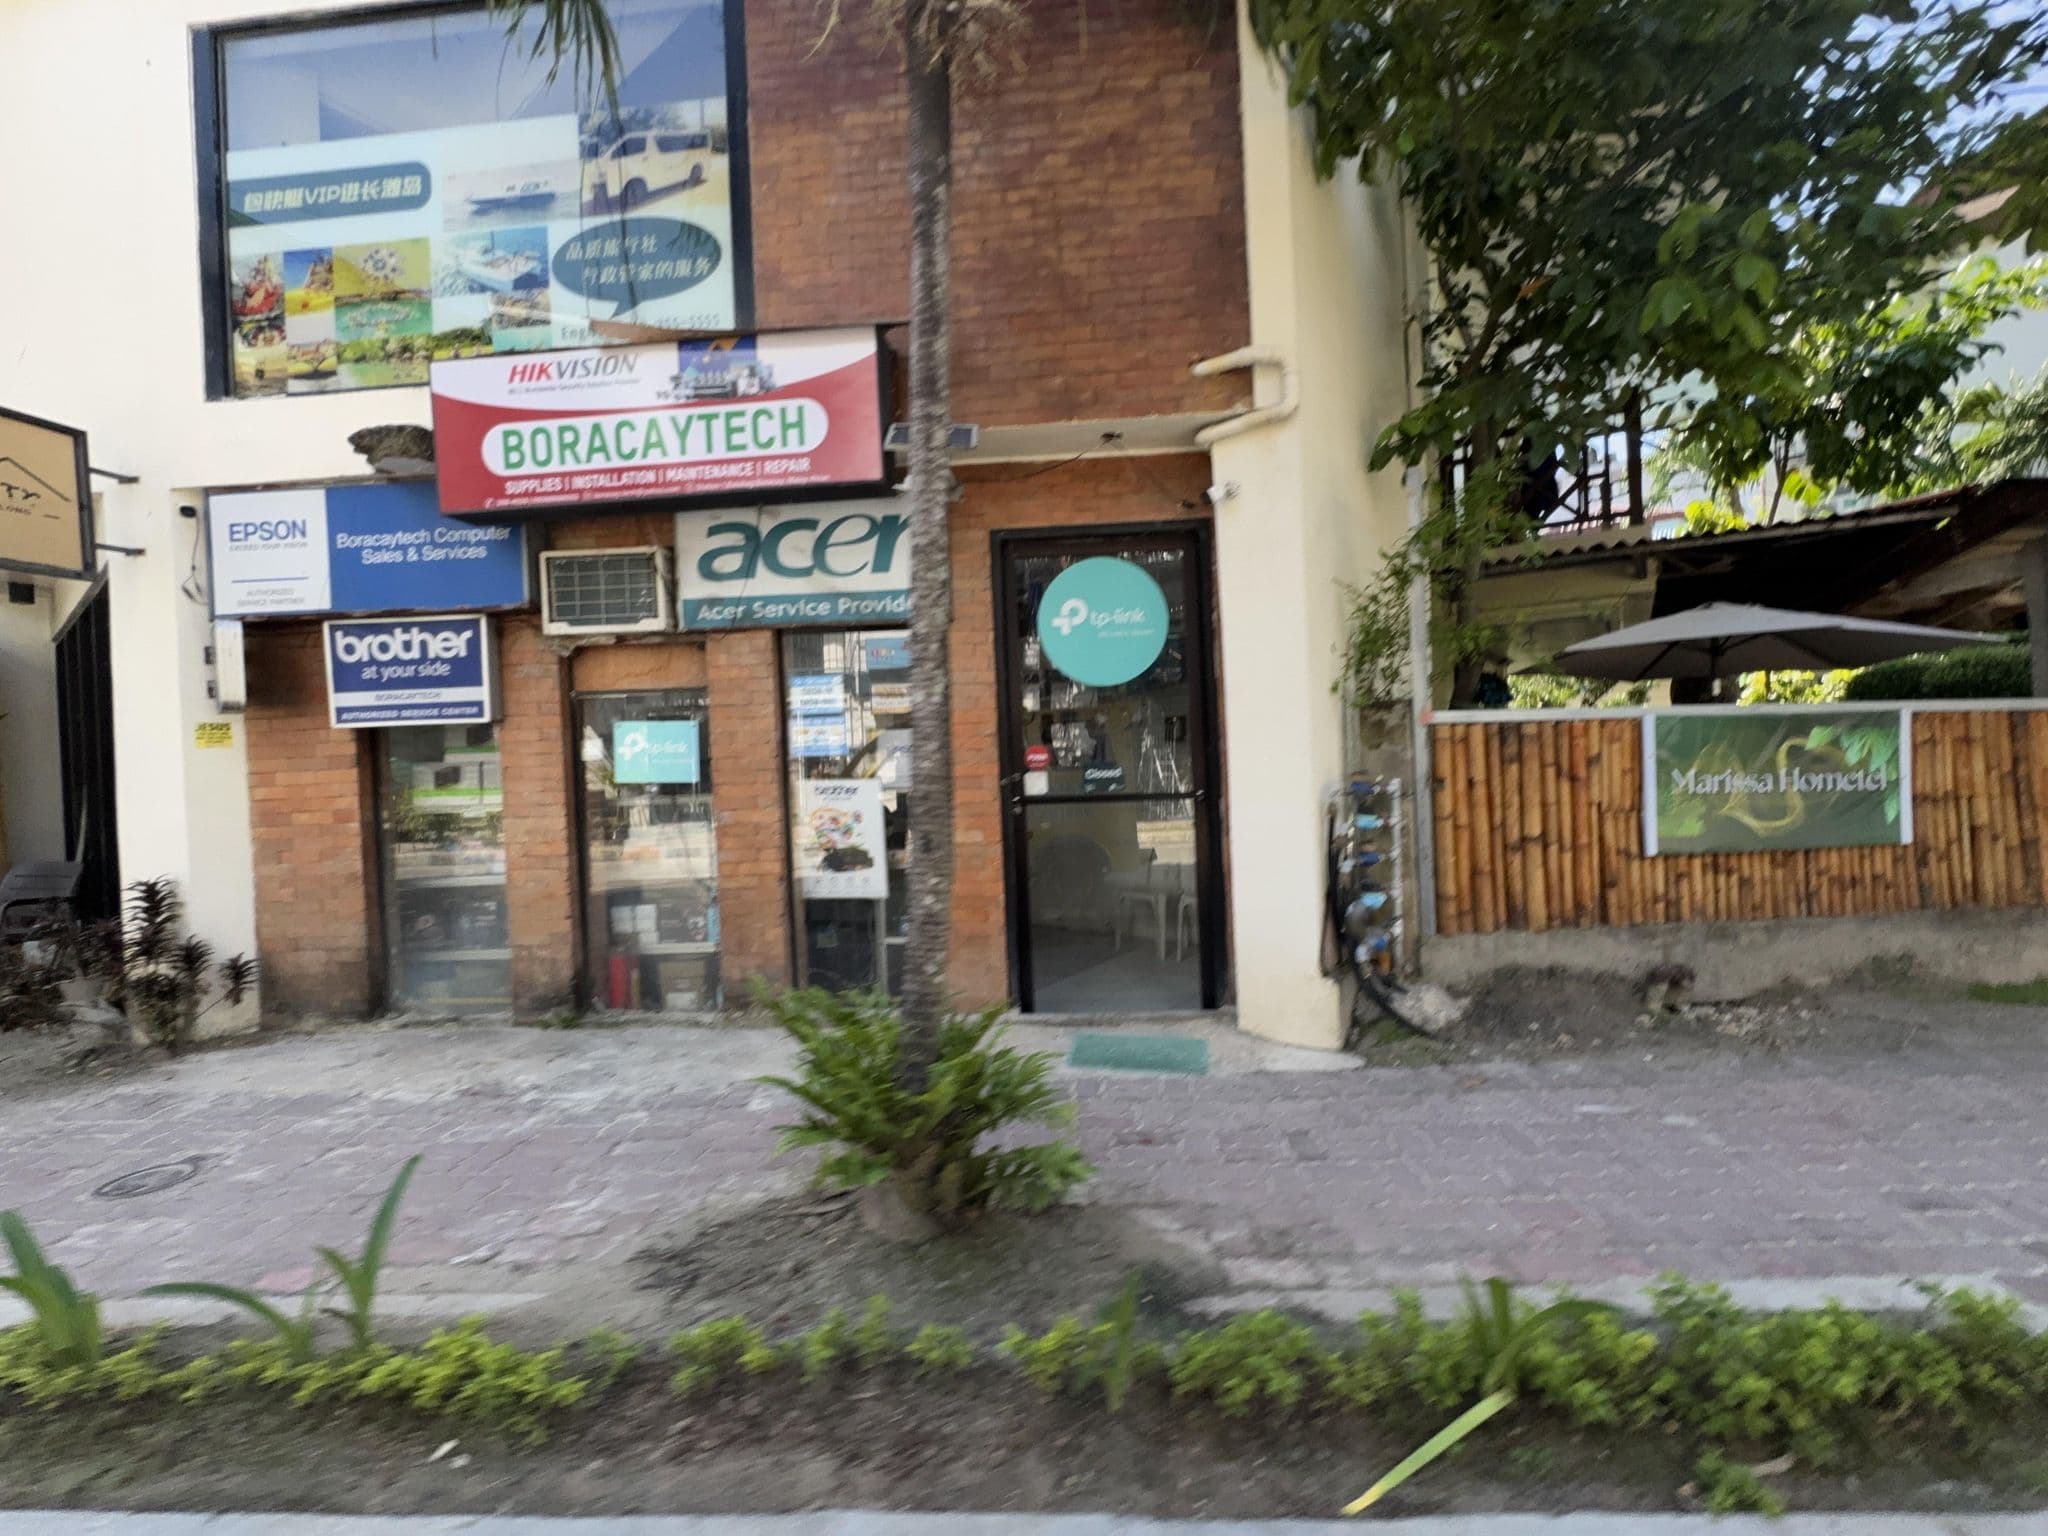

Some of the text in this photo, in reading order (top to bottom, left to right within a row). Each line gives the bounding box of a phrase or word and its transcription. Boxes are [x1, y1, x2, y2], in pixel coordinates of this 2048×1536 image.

[508, 353, 640, 385] HIKVISION
[502, 404, 807, 471] BORACAYTECH
[505, 477, 562, 496] SUPPLIES
[572, 469, 656, 491] INSTALLATION
[666, 462, 754, 483] MAINTENANCE
[764, 457, 812, 474] REPAIR
[228, 519, 307, 542] EPSON
[336, 526, 512, 549] Boracaytech Computer
[361, 544, 488, 565] Sales & Services
[697, 513, 912, 582] acer
[696, 594, 912, 621] Acer Service Provid
[334, 626, 474, 664] brother
[361, 660, 451, 682] at your side
[1671, 763, 1889, 795] Marissa Hometel
